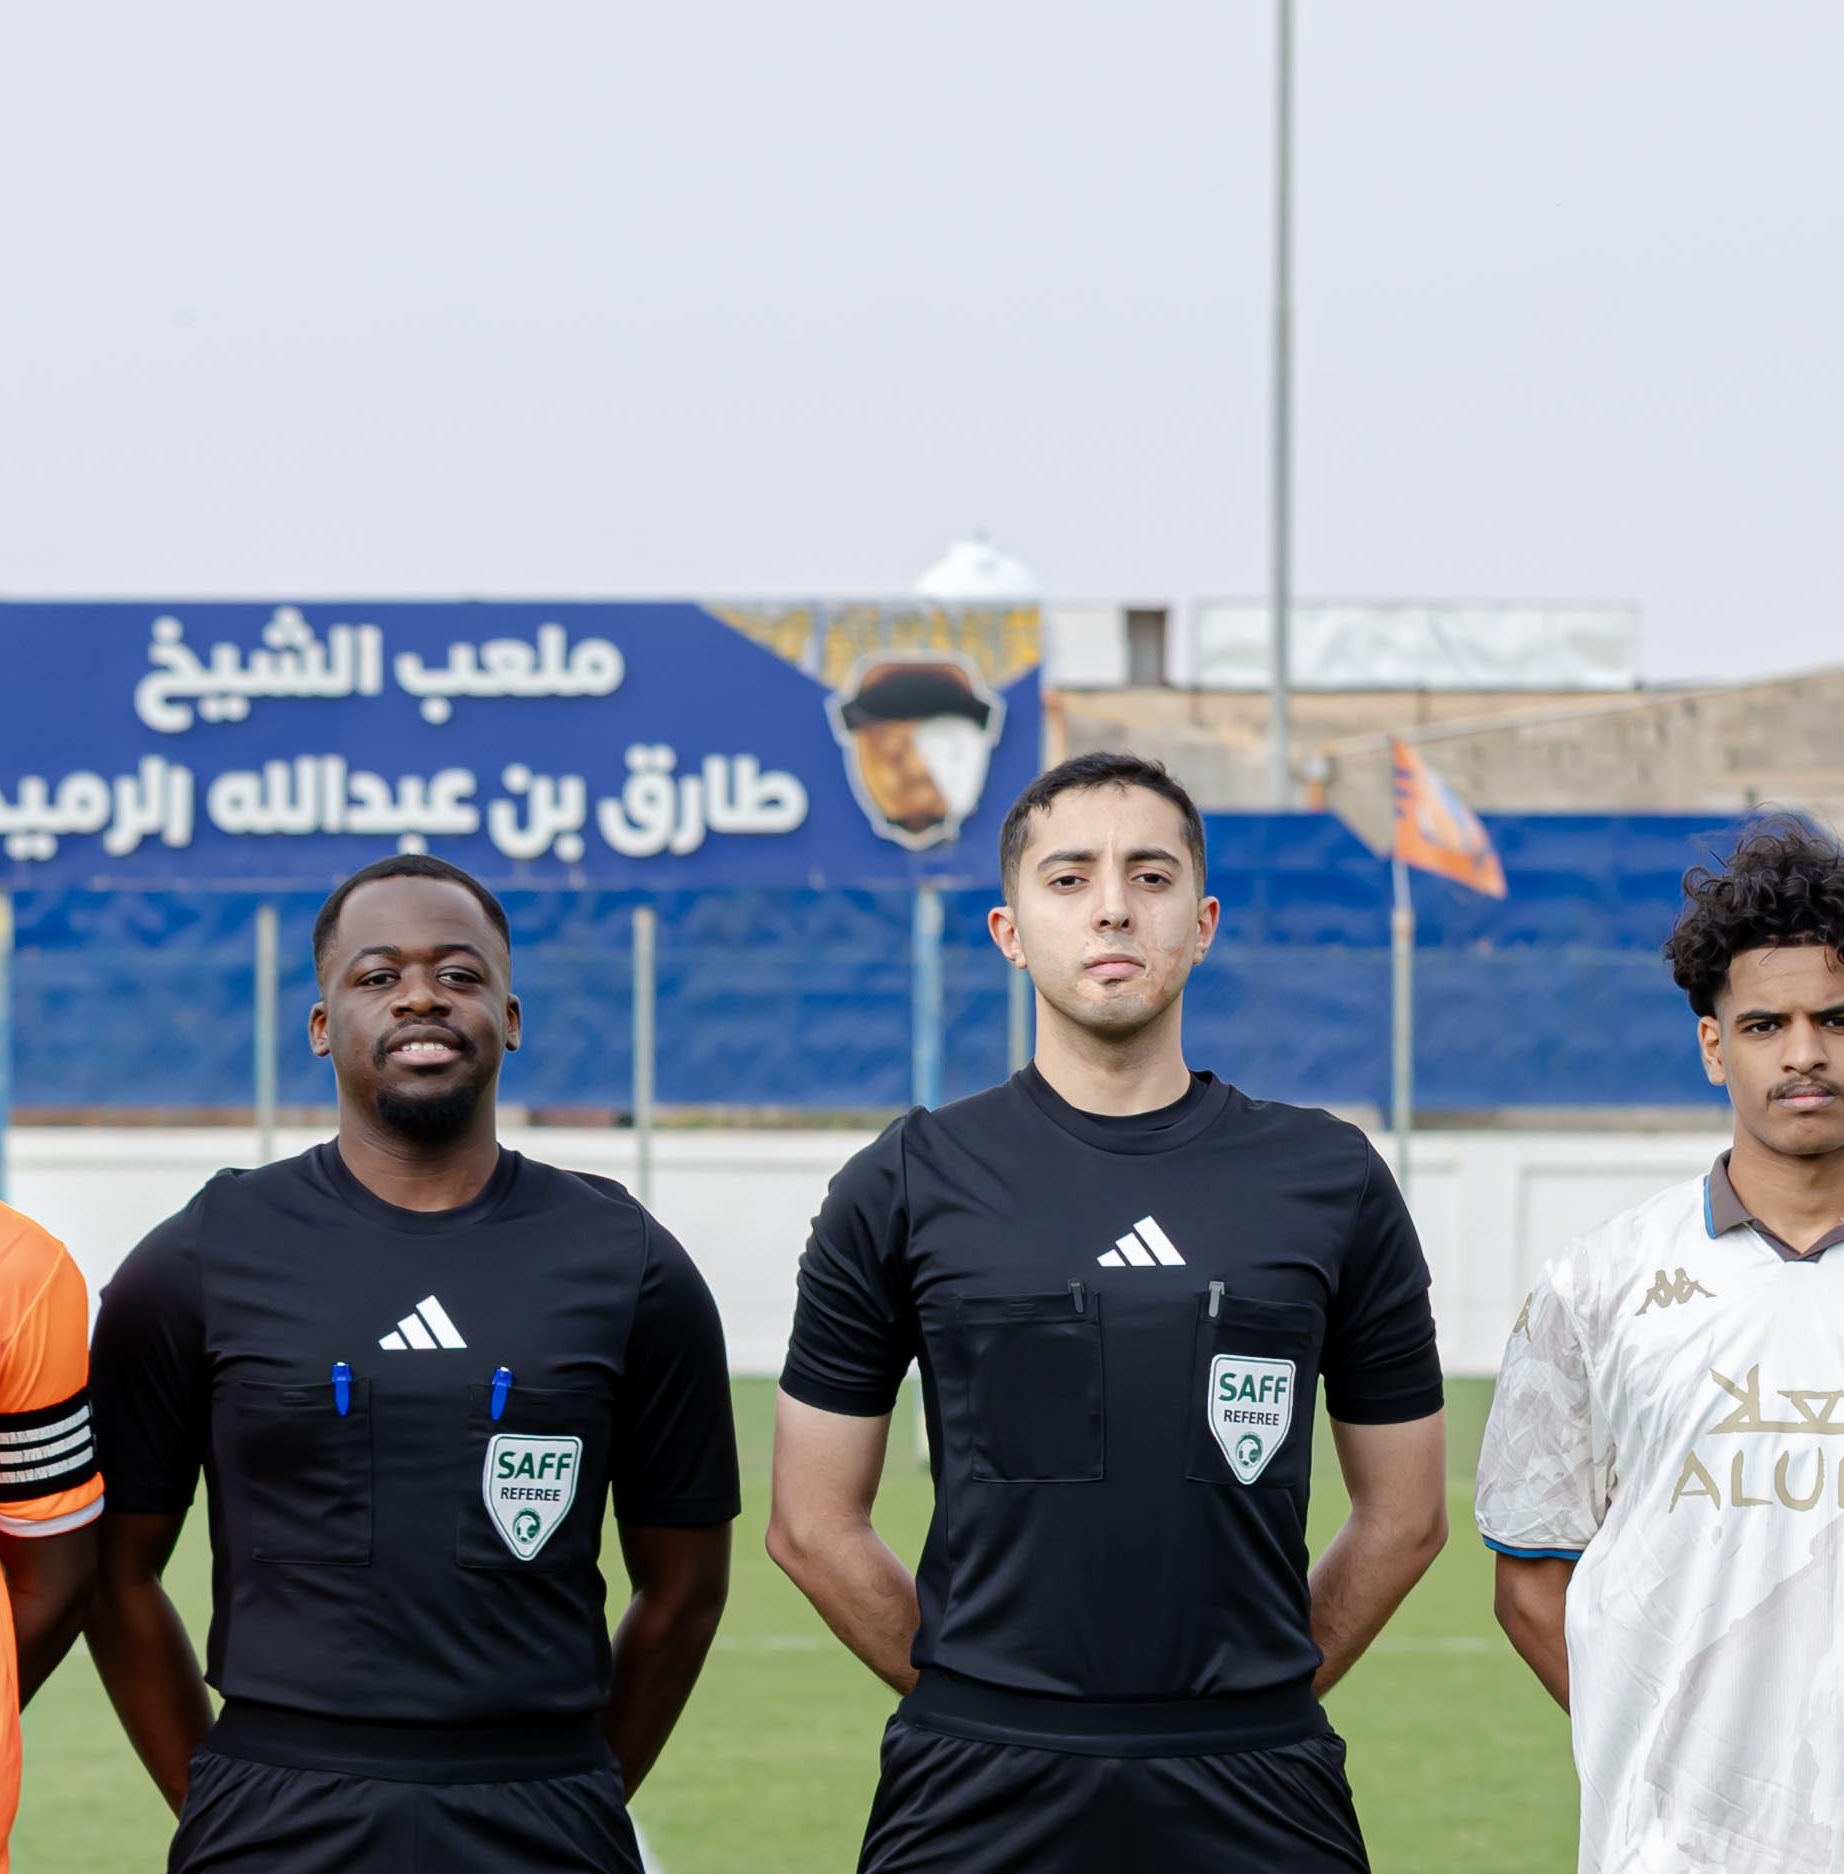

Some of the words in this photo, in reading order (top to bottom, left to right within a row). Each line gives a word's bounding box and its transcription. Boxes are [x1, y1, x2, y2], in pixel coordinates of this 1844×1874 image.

[134, 605, 384, 734] الشيخ
[393, 622, 626, 725] ملعب
[207, 754, 480, 856] عبدالله
[488, 764, 587, 862] بن
[596, 743, 809, 858] طارق
[1218, 1372, 1289, 1404] SAFF
[1223, 1409, 1281, 1426] REFEREE
[496, 1450, 573, 1480] SAFF
[500, 1486, 562, 1502] REFEREE
